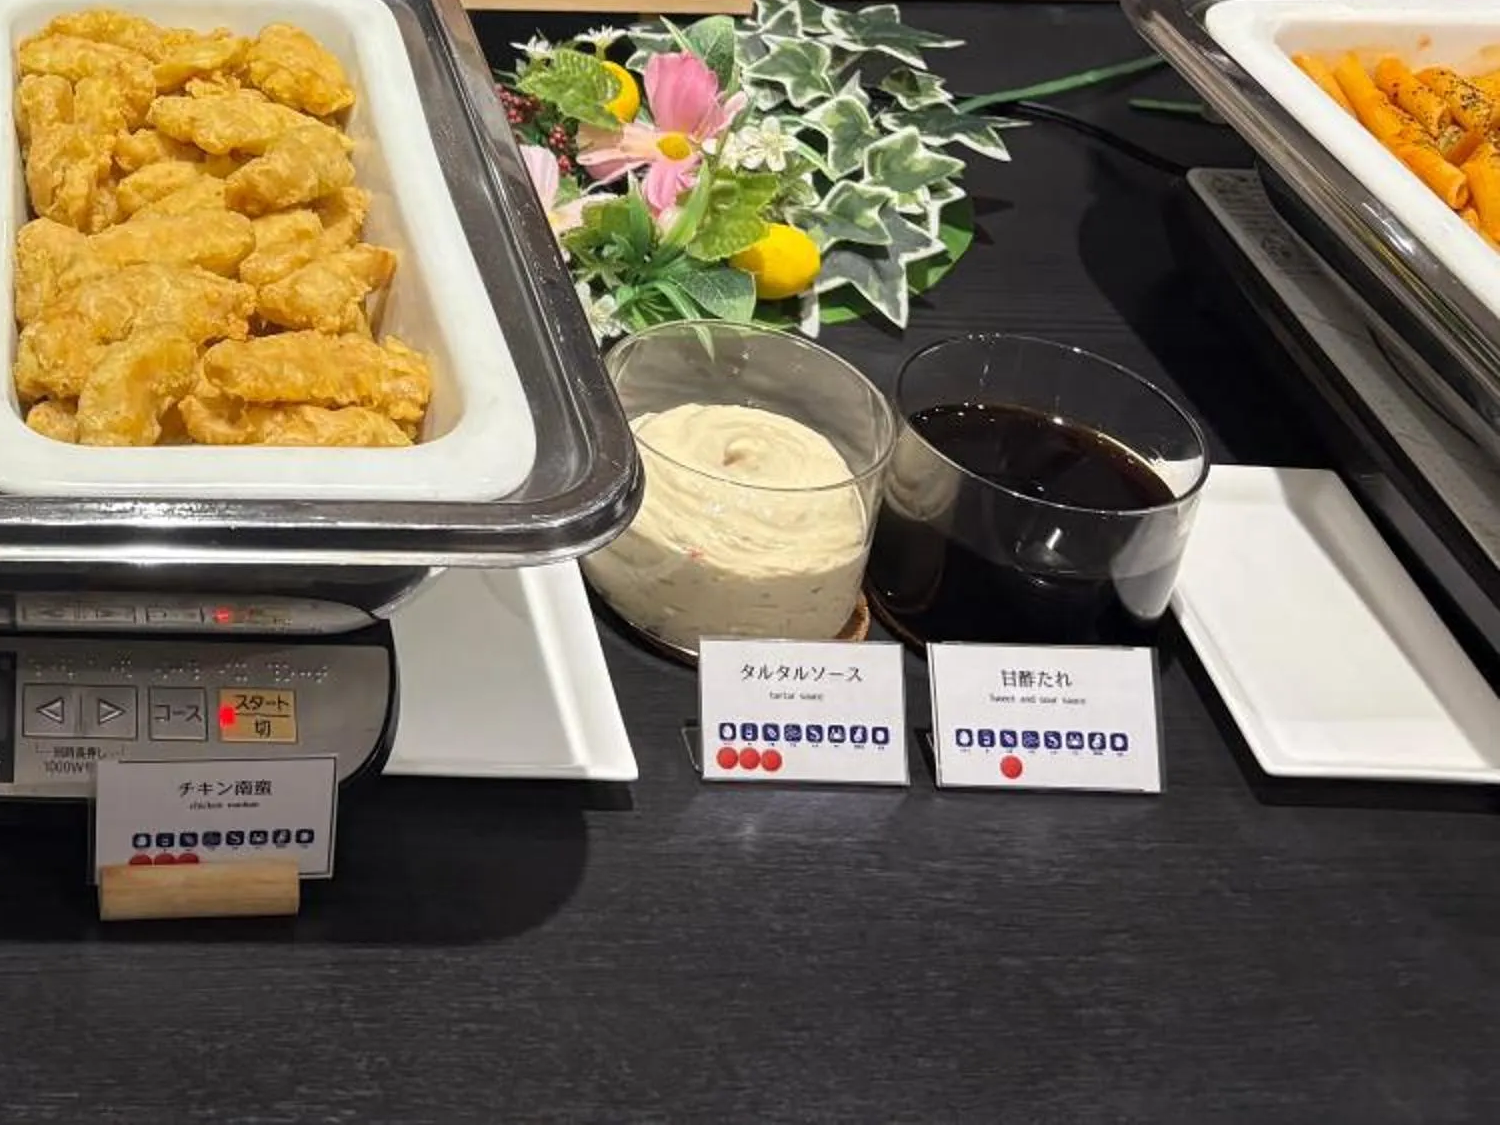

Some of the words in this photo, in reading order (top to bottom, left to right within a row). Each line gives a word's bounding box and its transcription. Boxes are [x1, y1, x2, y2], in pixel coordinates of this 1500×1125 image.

[740, 663, 863, 682] タルタルソース
[1001, 669, 1074, 688] 甘酢たれ
[234, 693, 290, 712] スタート
[152, 704, 203, 723] コース
[253, 720, 272, 737] 切
